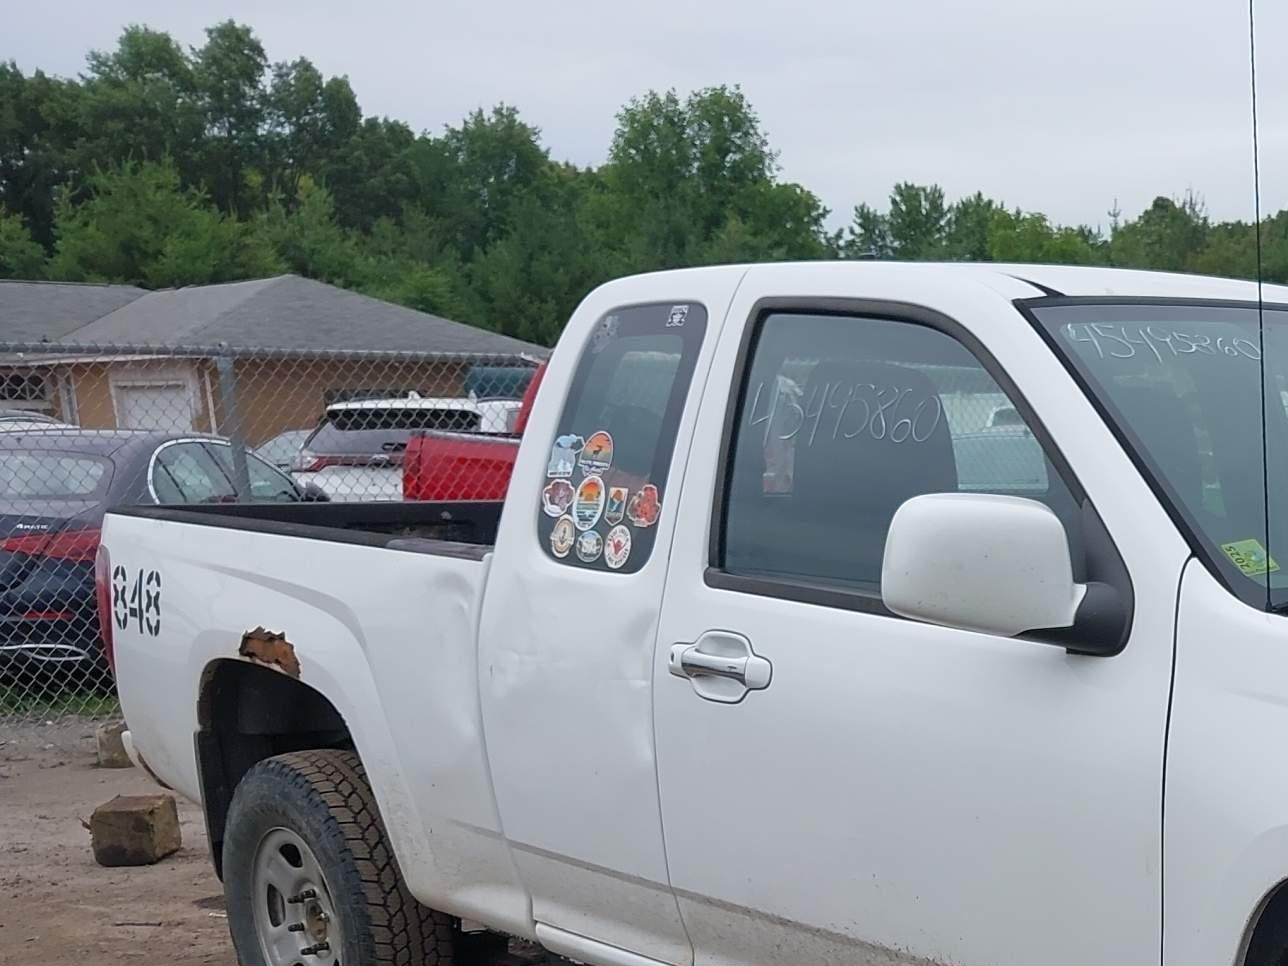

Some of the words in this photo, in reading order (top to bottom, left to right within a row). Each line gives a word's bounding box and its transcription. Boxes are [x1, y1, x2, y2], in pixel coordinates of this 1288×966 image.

[1066, 322, 1262, 364] 45495860
[750, 382, 942, 447] 45495860
[113, 565, 161, 637] 848
